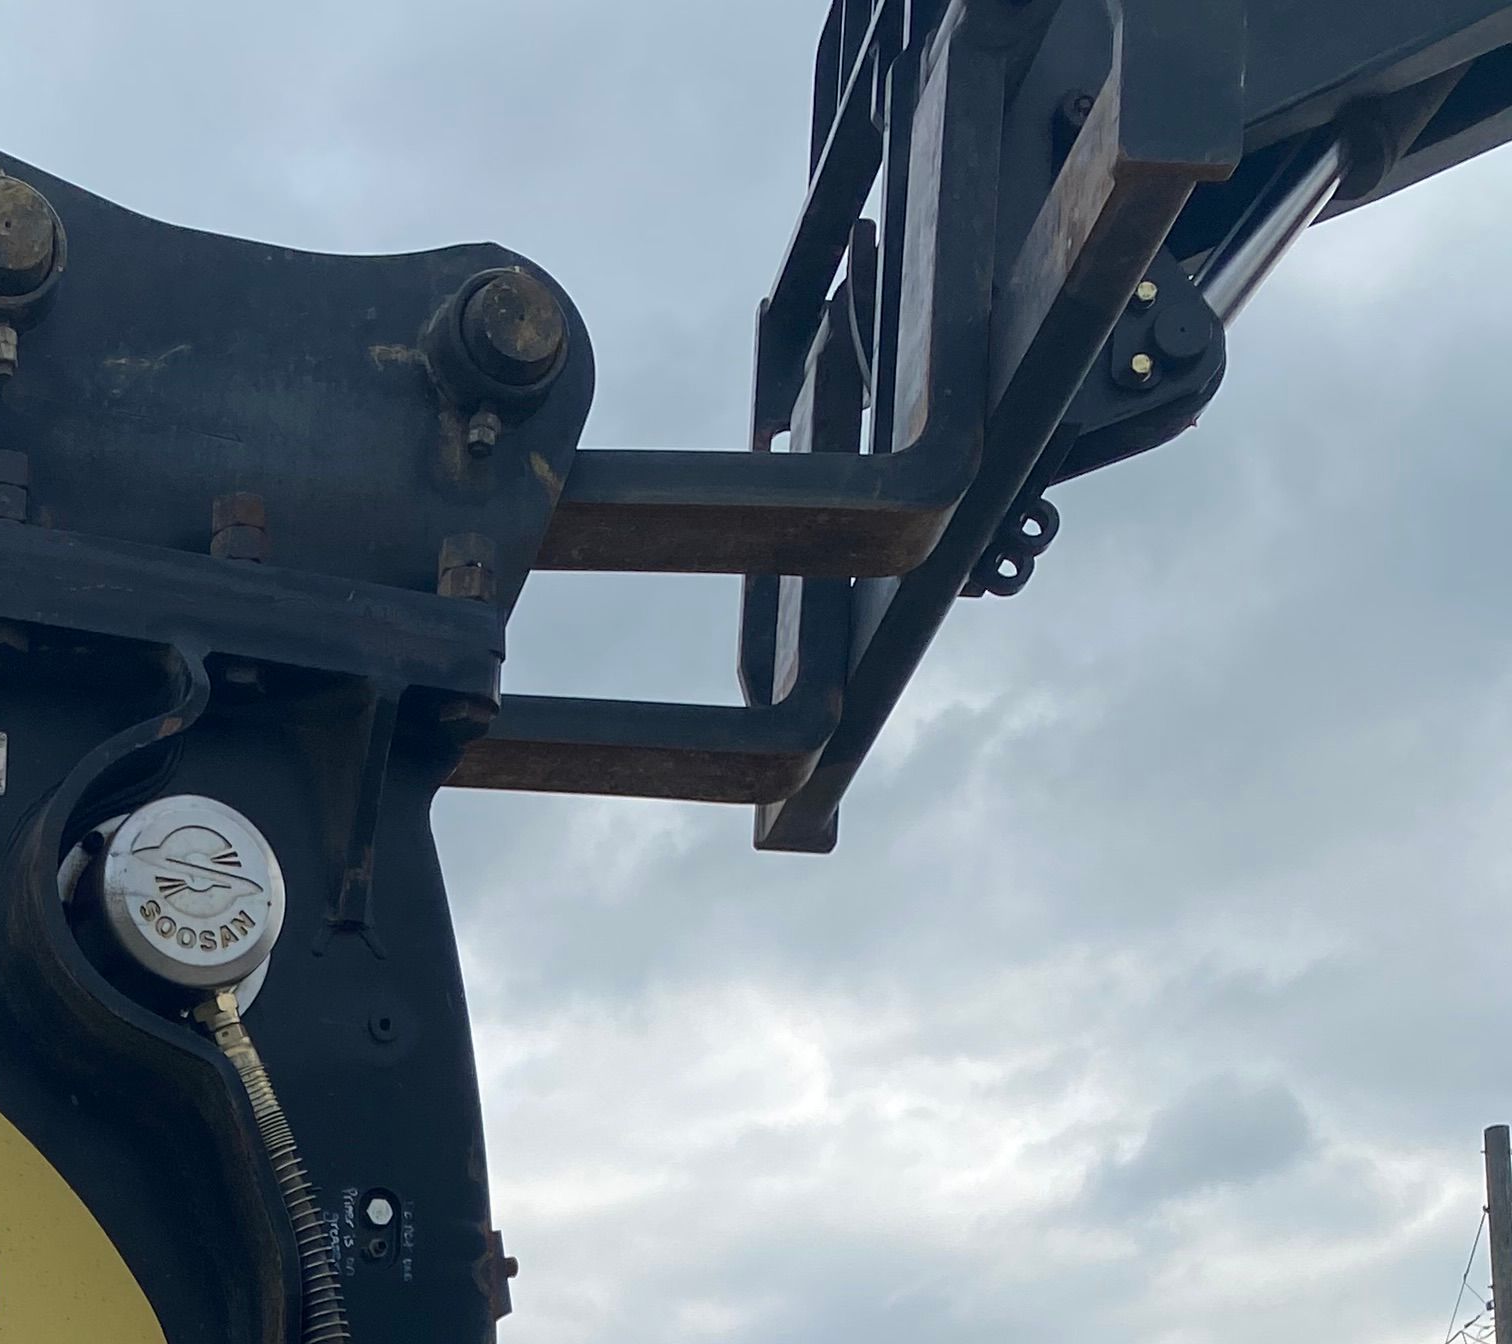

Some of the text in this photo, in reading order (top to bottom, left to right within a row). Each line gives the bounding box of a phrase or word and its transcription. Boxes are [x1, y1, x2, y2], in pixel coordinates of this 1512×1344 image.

[140, 899, 256, 952] SOOSAN
[342, 1187, 359, 1229] Primer
[344, 1235, 356, 1248] is
